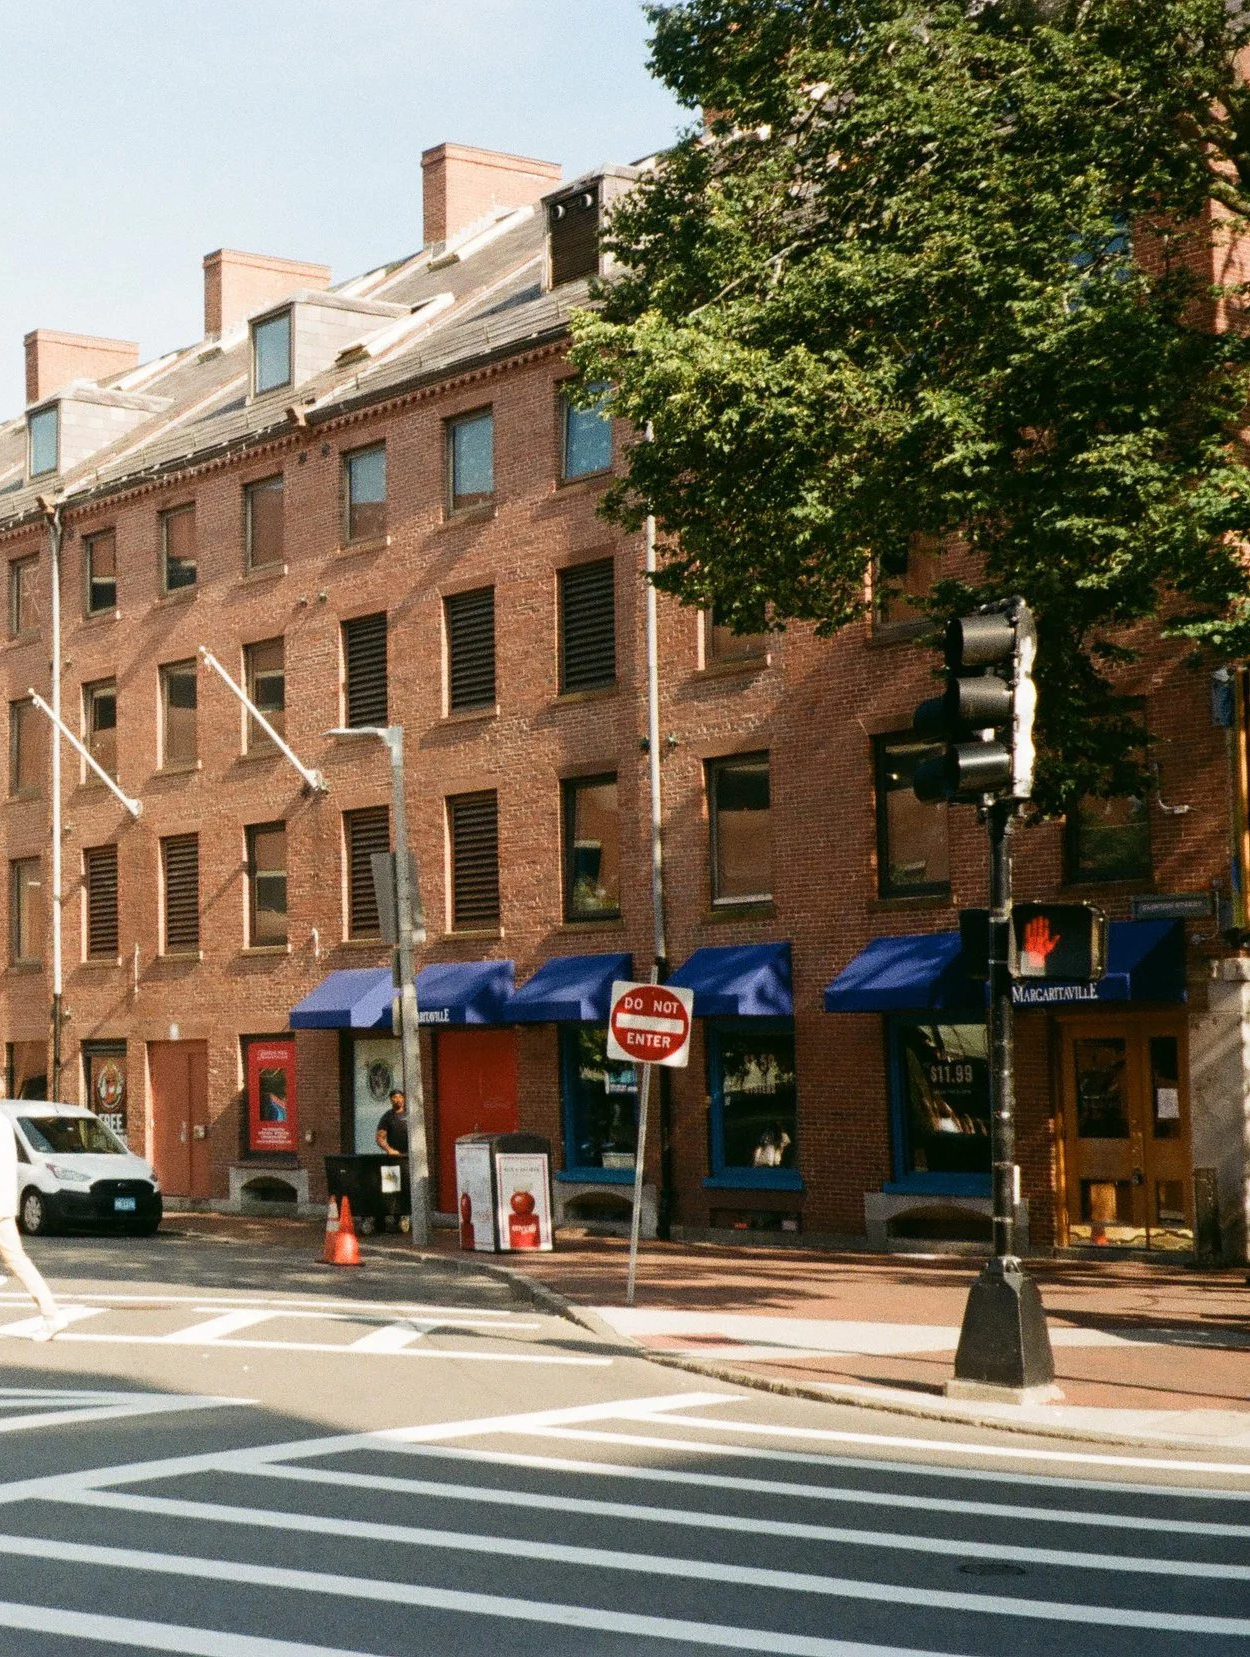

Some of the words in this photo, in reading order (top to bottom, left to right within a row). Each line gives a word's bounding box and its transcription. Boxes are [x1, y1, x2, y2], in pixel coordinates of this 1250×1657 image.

[1011, 982, 1099, 1003] MARGARITAVILLE
[624, 997, 643, 1010] DO
[653, 1000, 679, 1014] NOT
[627, 1032, 671, 1049] ENTER
[930, 1064, 973, 1084] $11.99
